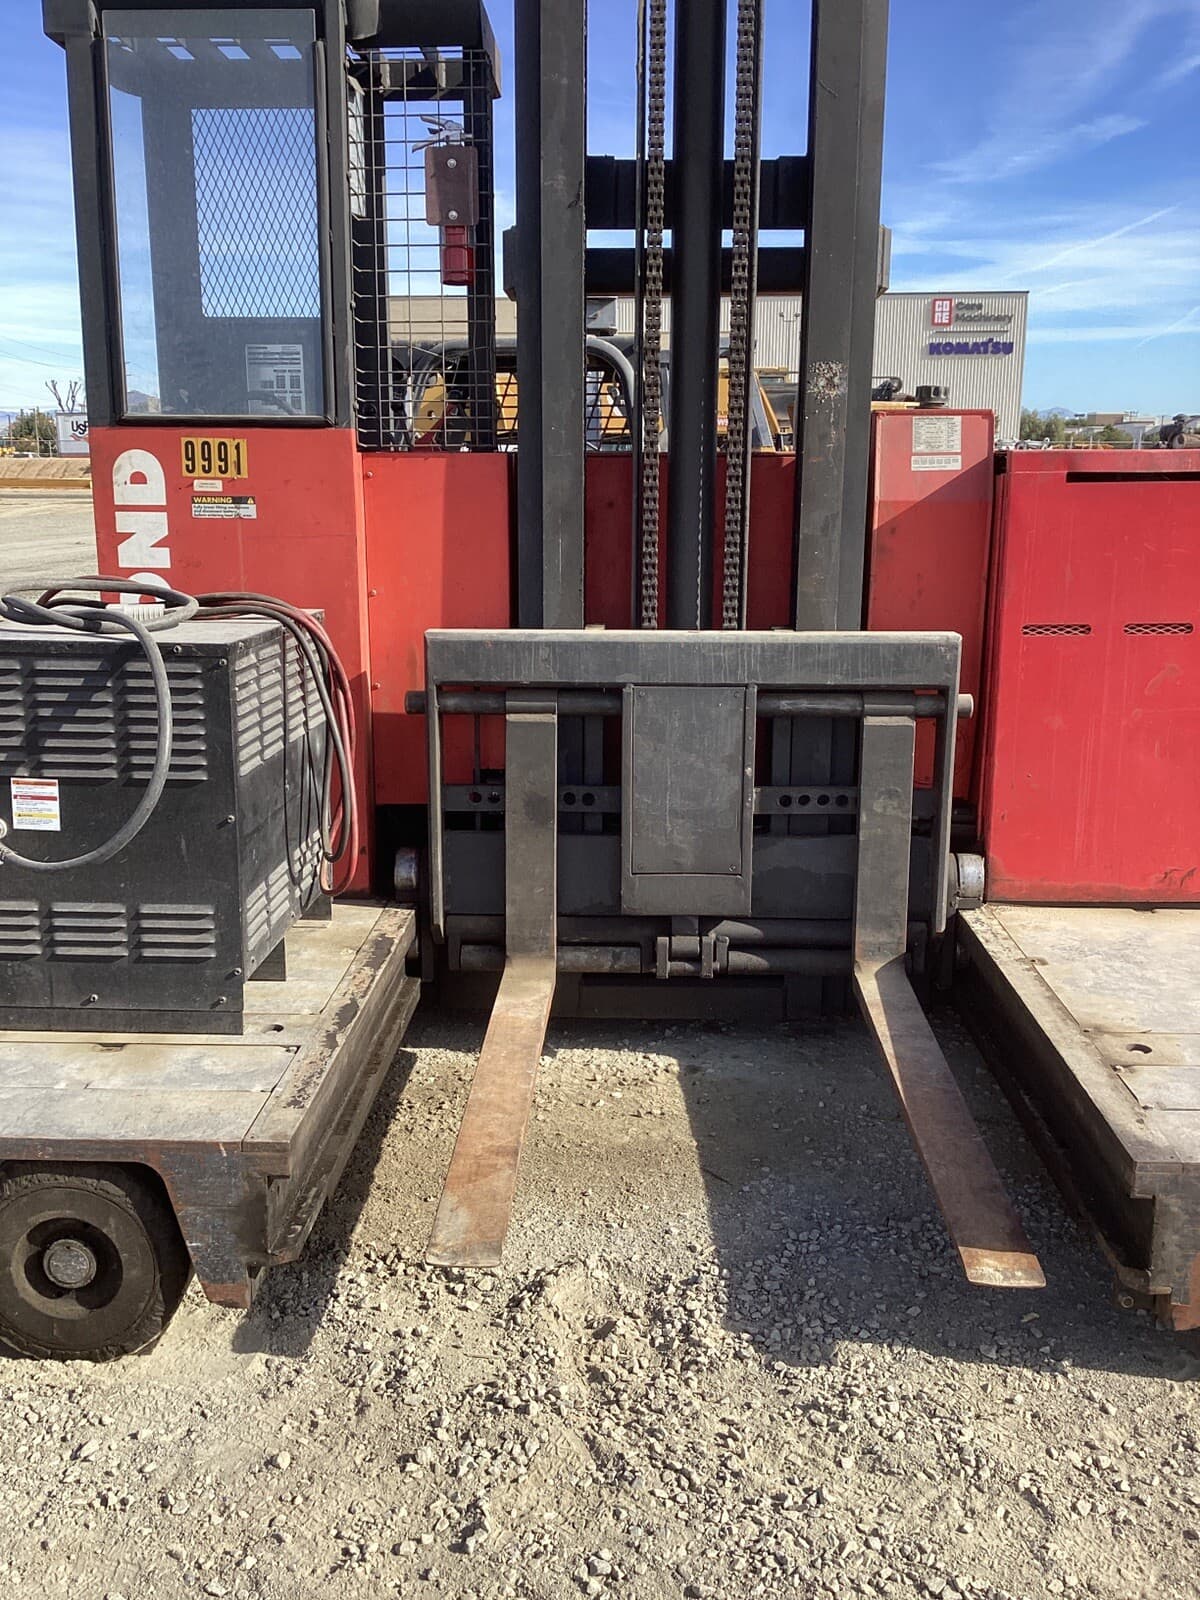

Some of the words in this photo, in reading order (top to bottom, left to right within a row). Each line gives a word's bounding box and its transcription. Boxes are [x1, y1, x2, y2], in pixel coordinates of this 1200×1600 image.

[956, 302, 983, 311] Core
[955, 312, 1014, 324] Machinery
[928, 338, 1014, 355] KOMATSU
[184, 440, 242, 475] 9991
[193, 496, 233, 504] WARNING
